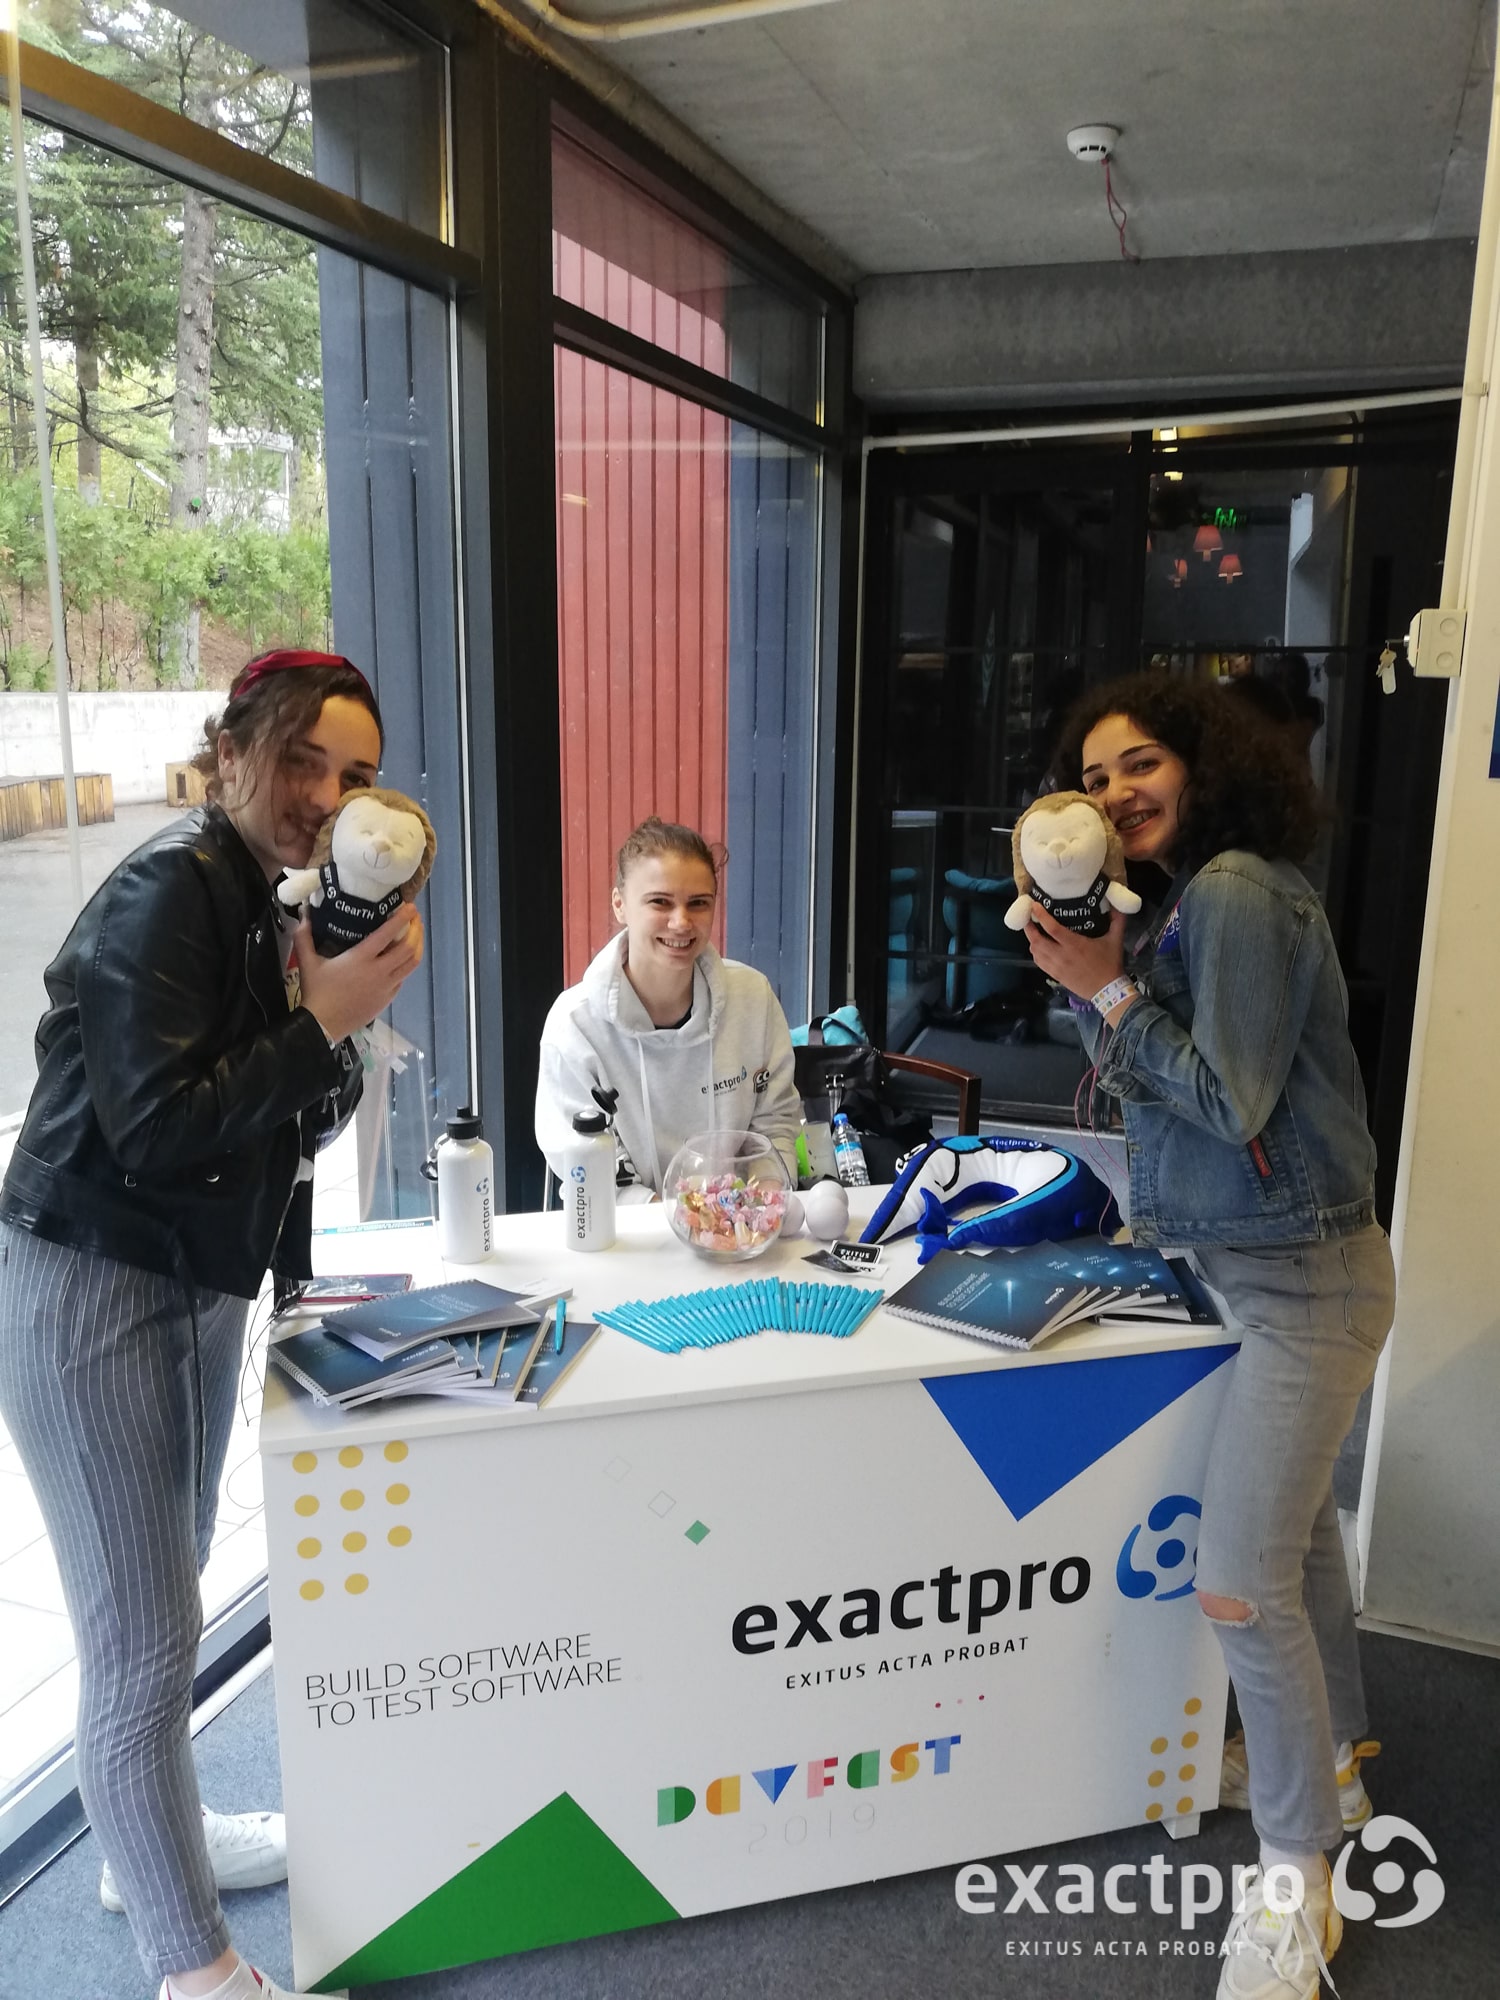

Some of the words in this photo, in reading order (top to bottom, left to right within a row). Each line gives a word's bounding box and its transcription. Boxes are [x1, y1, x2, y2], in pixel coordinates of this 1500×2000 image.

[335, 900, 375, 920] ClearTH
[1053, 907, 1091, 917] ClearTH
[701, 1075, 741, 1094] eactpro
[482, 1198, 491, 1253] exactpro
[575, 1186, 587, 1239] exactpro
[732, 1556, 1091, 1655] exactpro
[306, 1663, 406, 1700] BUILD
[418, 1633, 591, 1683] SOFTWARE
[786, 1663, 866, 1689] EXITUS
[878, 1652, 933, 1675] ACTA
[944, 1636, 1029, 1663] PROBAT
[308, 1700, 355, 1729] TO
[362, 1686, 441, 1720] TEST
[452, 1657, 622, 1707] SOFTWARE
[746, 1802, 876, 1855] 2019
